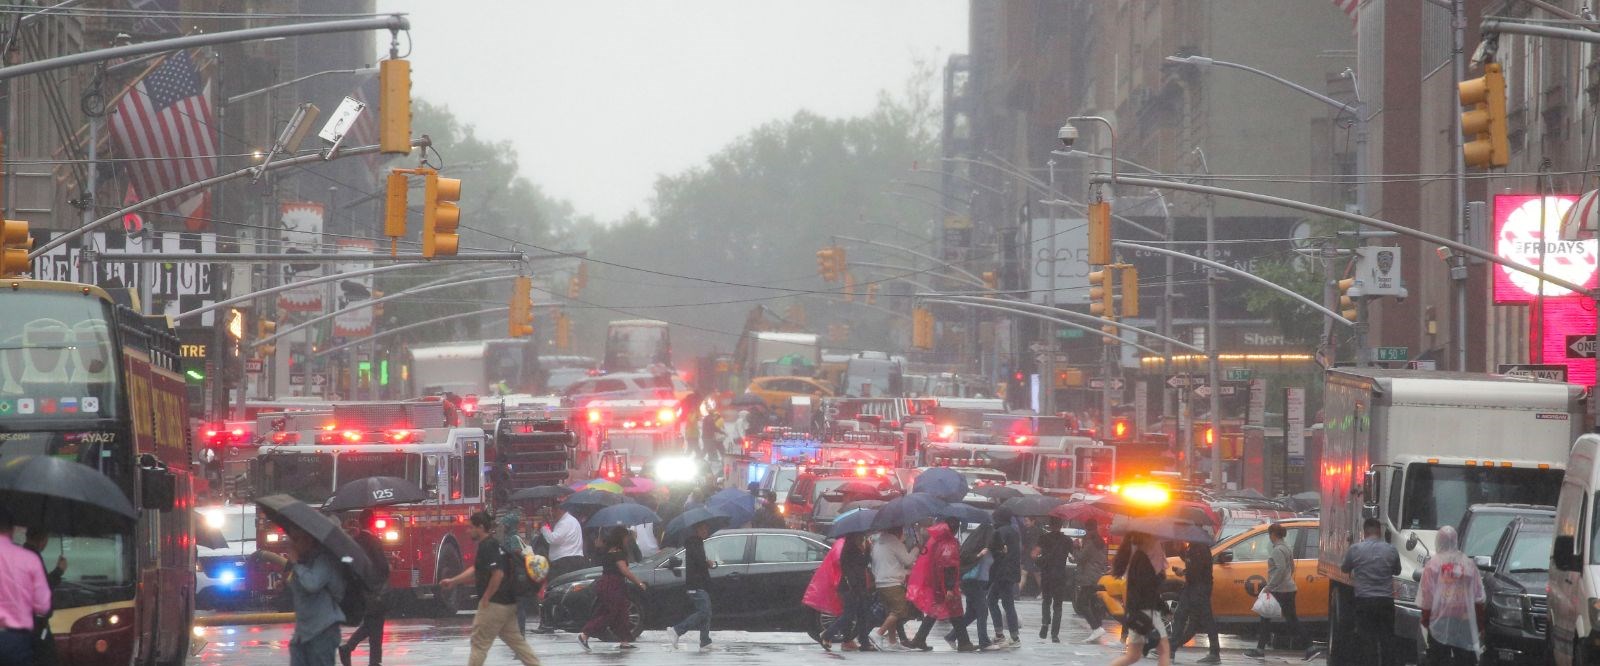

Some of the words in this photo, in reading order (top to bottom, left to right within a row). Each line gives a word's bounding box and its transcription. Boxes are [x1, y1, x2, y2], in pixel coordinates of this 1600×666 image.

[180, 344, 206, 358] TRE
[1380, 349, 1387, 360] W
[1538, 371, 1560, 381] WAY
[81, 432, 116, 443] AYA27
